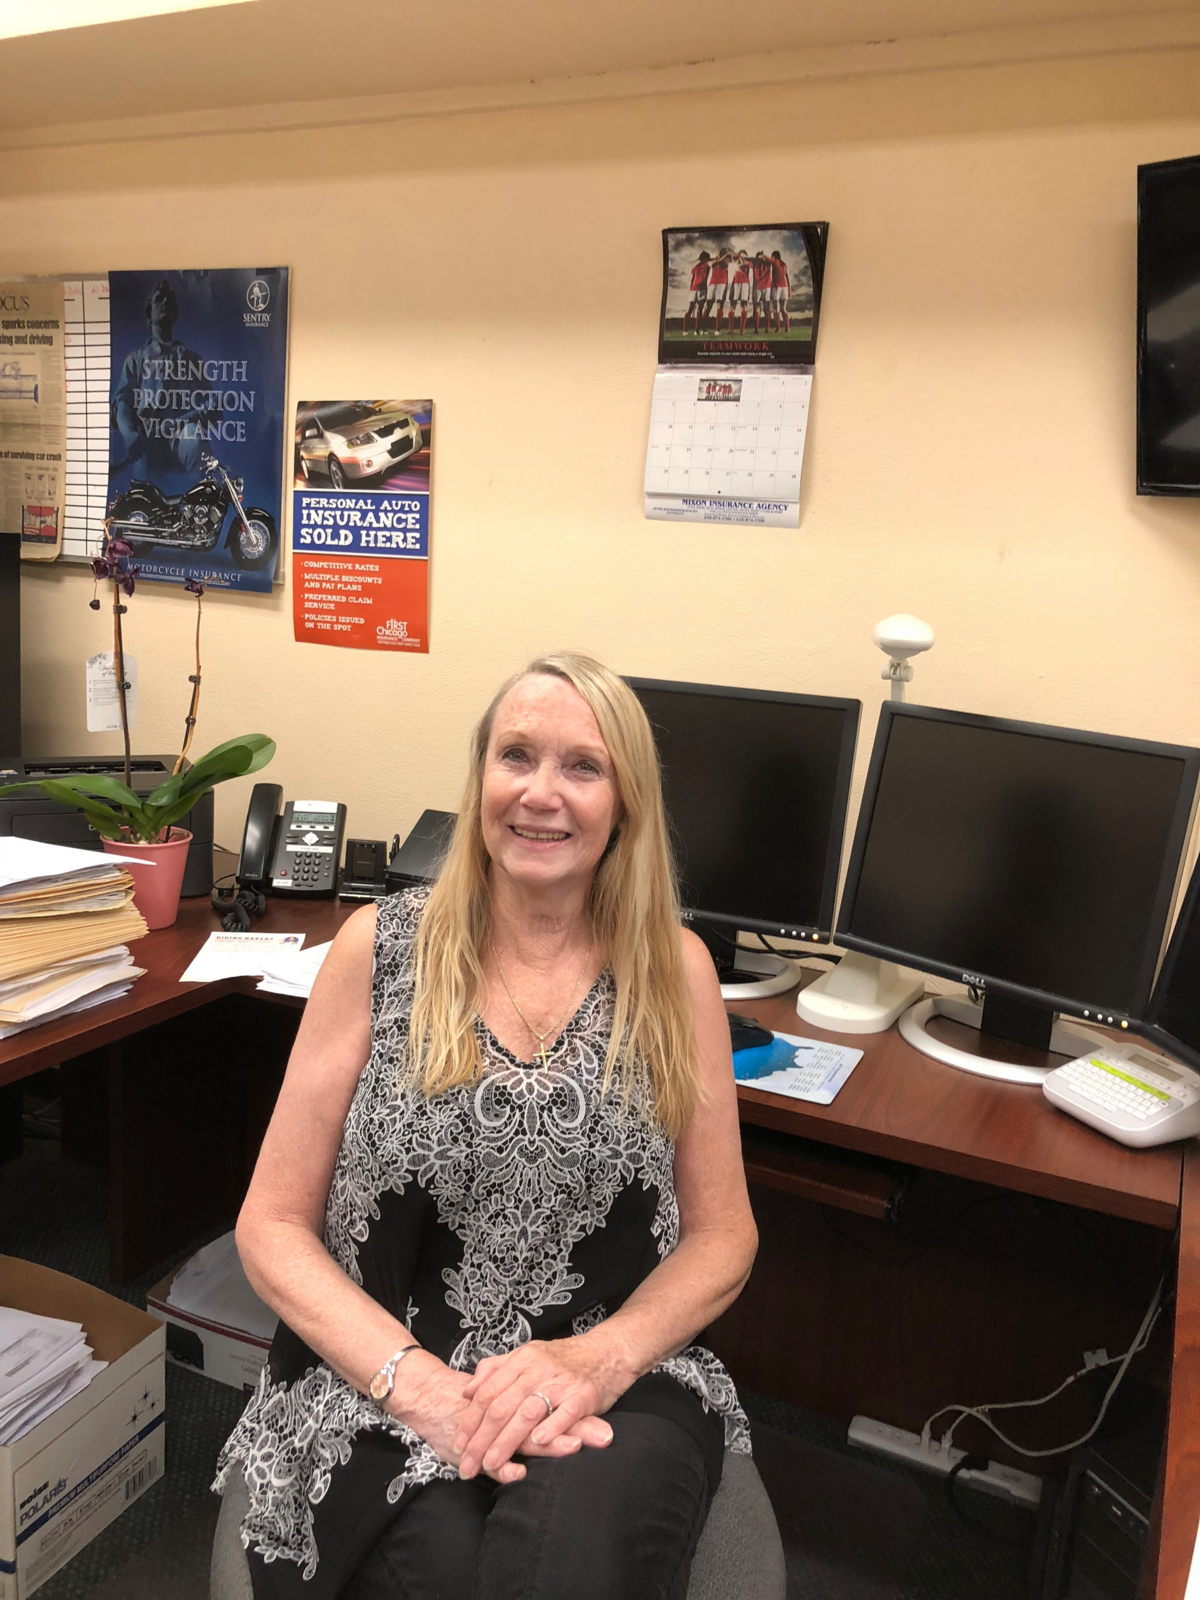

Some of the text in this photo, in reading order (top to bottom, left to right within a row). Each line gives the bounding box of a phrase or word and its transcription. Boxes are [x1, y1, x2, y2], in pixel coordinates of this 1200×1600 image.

[0, 295, 30, 311] CUS
[243, 313, 271, 322] SENTRY
[2, 319, 60, 330] sparks concerns
[14, 334, 28, 345] and
[29, 334, 53, 346] driving
[701, 341, 769, 350] TEAMWORK
[142, 359, 248, 381] STRENGTH
[132, 388, 256, 412] PROTECTION
[141, 418, 246, 442] VIGILANCE
[11, 450, 35, 461] surviving
[46, 453, 62, 461] crash
[302, 497, 421, 511] PERSONAL AUTO
[709, 500, 753, 509] INSURANCE
[756, 503, 788, 511] AGENCY
[301, 509, 420, 529] INSURANCE
[300, 528, 420, 549] SOLD HERE
[304, 561, 353, 570] COMPETITIVE
[127, 563, 185, 576] MOTORCYCLE
[189, 569, 242, 582] INSURANCE
[304, 573, 382, 584] MULTIPLE DISCOUNTS
[304, 593, 346, 602] PREFERRED
[304, 602, 335, 610] SERVICE
[304, 614, 365, 624] POLICIES ISSUED
[386, 619, 407, 631] FIRST
[376, 626, 408, 639] Chicago
[962, 973, 986, 988] DELL
[48, 1488, 77, 1518] PREMIUM
[77, 1449, 120, 1494] MULTIPURPOSE
[120, 1434, 140, 1455] PAPER
